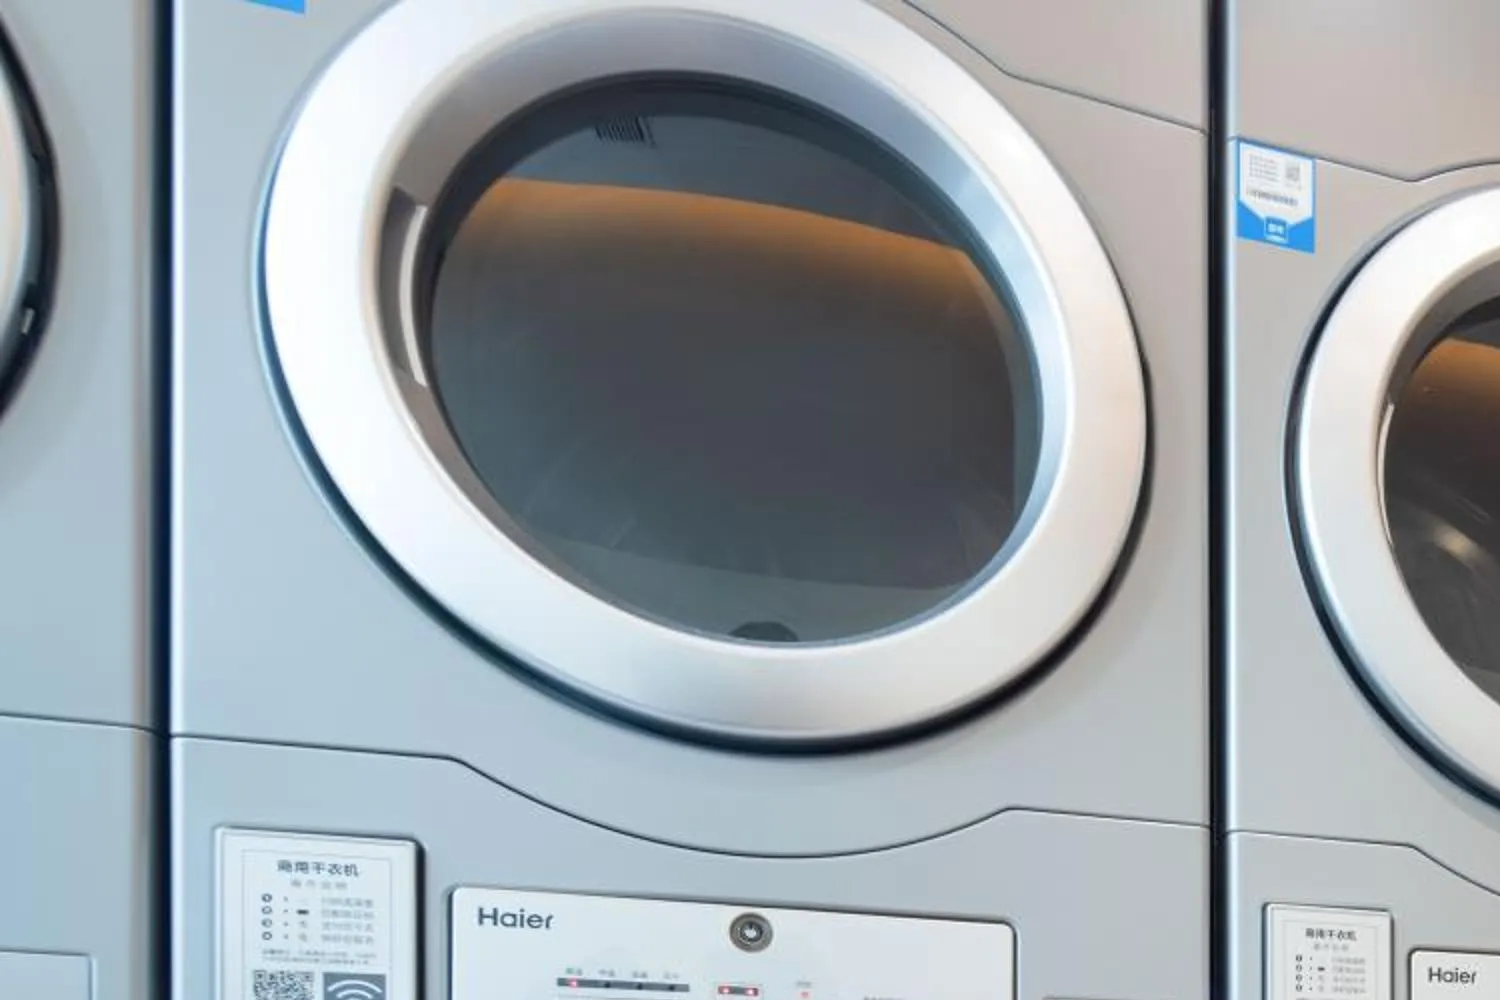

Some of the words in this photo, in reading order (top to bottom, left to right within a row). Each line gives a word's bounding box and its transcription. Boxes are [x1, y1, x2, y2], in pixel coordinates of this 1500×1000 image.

[277, 859, 360, 877] 商用干衣机
[477, 907, 554, 930] Haier
[1428, 966, 1477, 984] Haier
